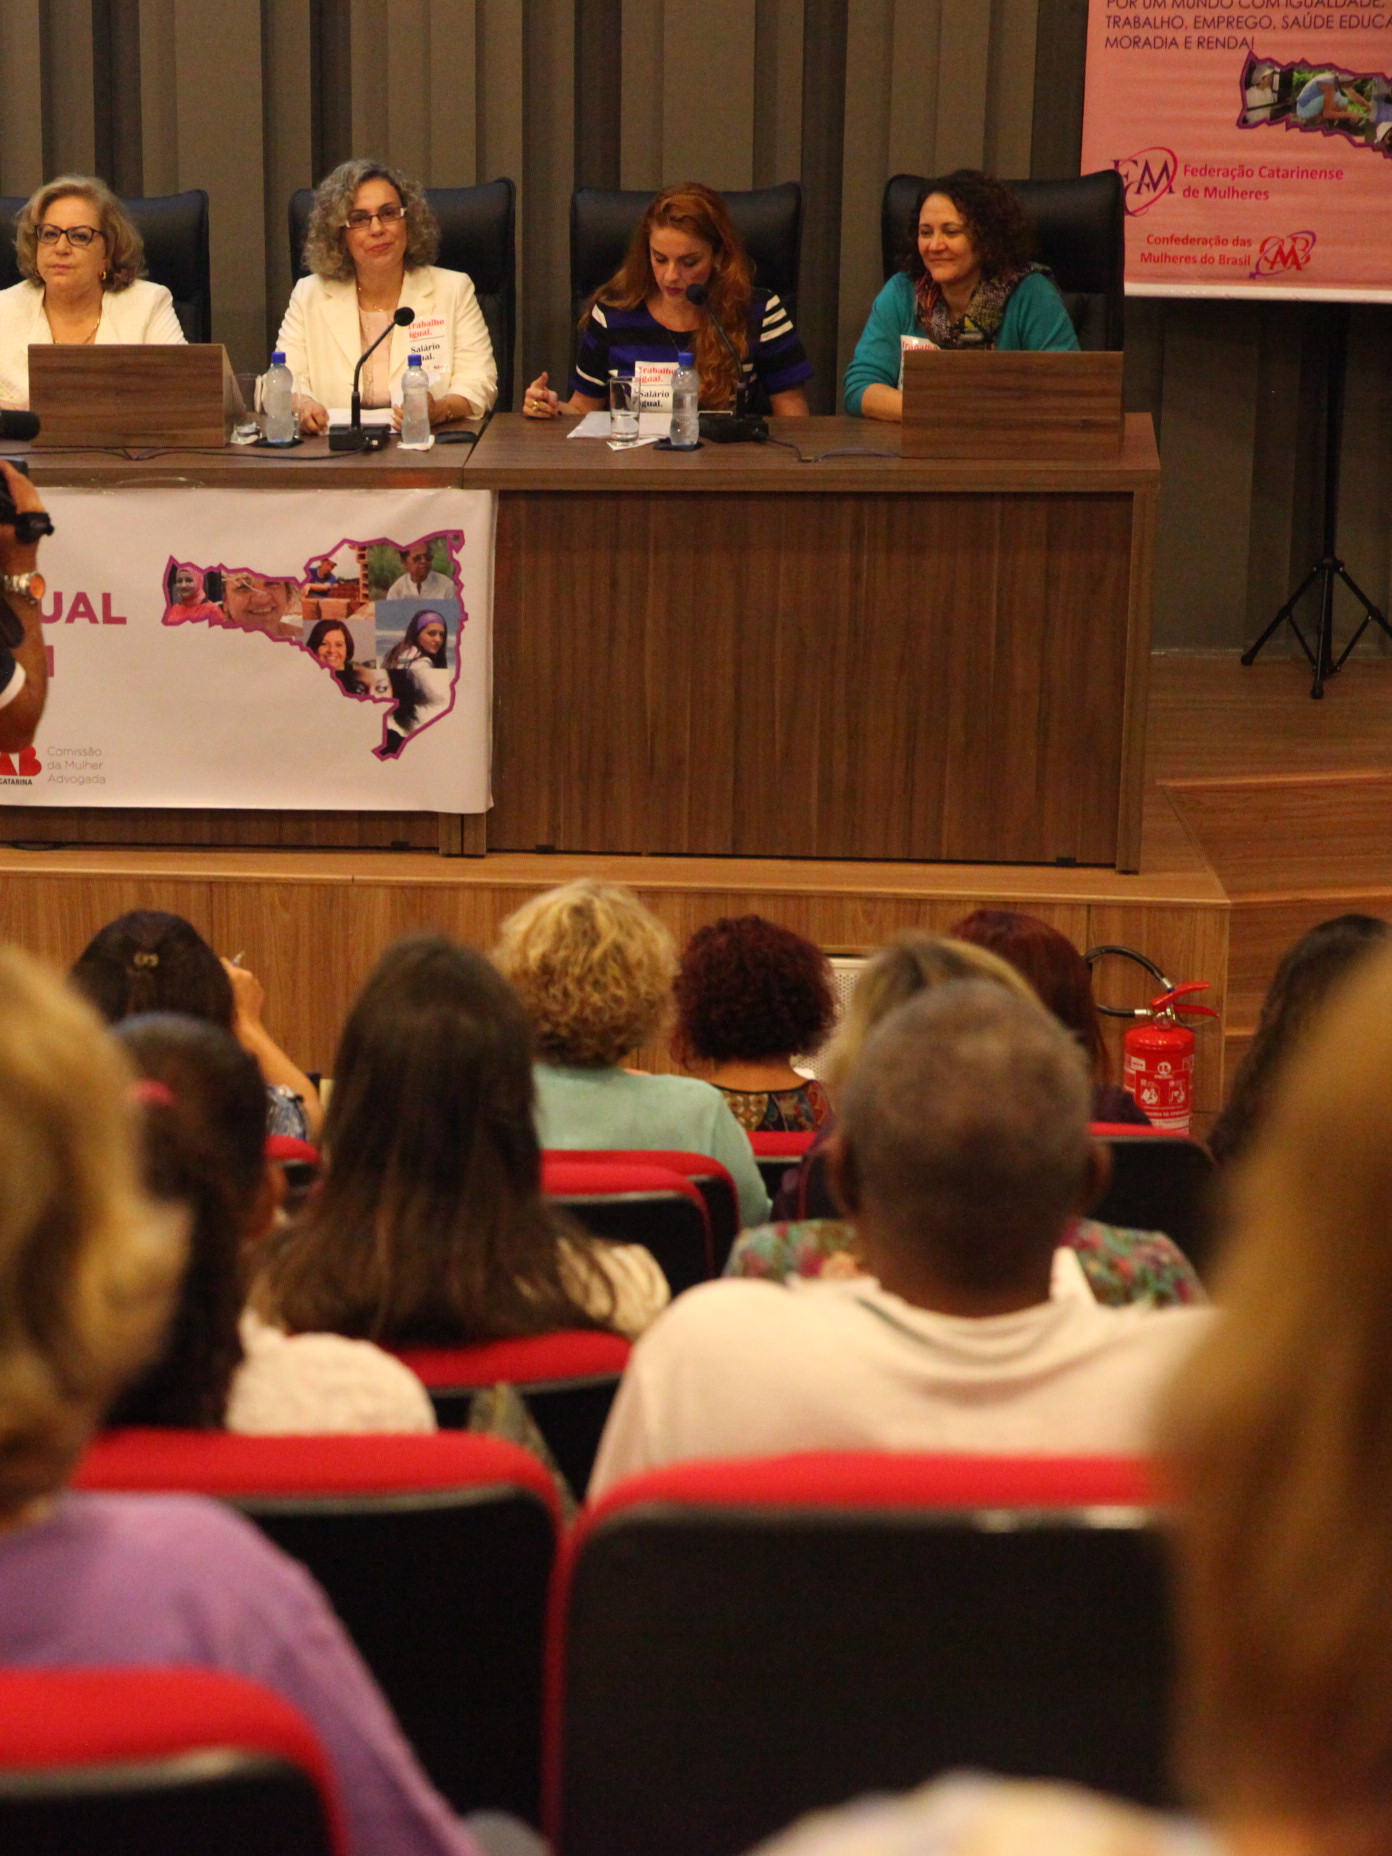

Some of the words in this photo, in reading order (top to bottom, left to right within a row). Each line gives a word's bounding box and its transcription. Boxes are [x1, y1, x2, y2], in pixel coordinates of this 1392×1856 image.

[1106, 14, 1188, 30] TRABALHO,
[1281, 11, 1335, 29] SAÚDE
[1339, 13, 1392, 29] EDUCA
[1105, 35, 1179, 49] MORADIA
[1184, 36, 1193, 49] E
[1196, 36, 1255, 50] RENDA!
[1183, 164, 1254, 181] Federação
[1258, 165, 1344, 180] Catarinense
[1182, 185, 1200, 199] de
[1203, 186, 1270, 201] Mulheres
[1146, 234, 1229, 249] Confederação
[1232, 235, 1252, 248] das
[1140, 252, 1198, 265] Mulheres
[1200, 253, 1215, 265] do
[1219, 254, 1251, 266] Brasil
[410, 343, 440, 353] Salário
[47, 746, 102, 757] Comissão
[47, 760, 62, 770] da
[65, 760, 103, 770] Mulher
[48, 774, 106, 786] Advogada
